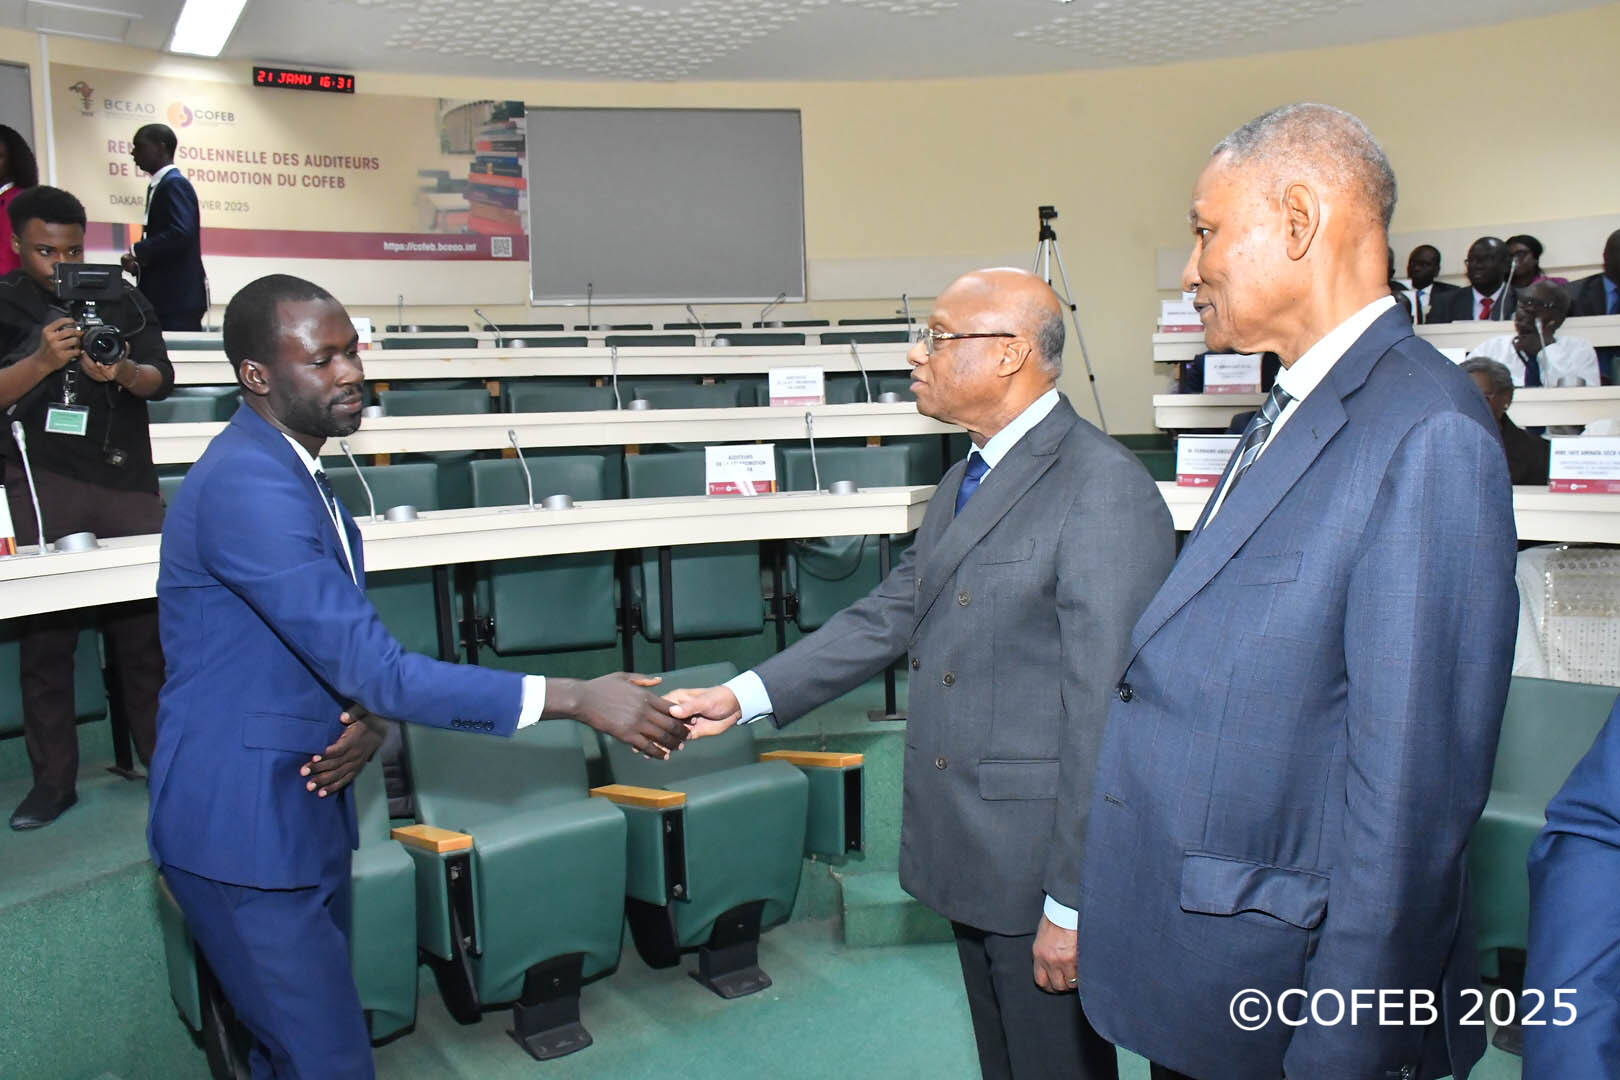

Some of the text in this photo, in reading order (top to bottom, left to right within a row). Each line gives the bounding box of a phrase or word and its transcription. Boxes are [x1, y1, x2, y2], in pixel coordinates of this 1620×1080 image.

[257, 70, 273, 83] 21
[277, 72, 312, 86] JANV
[104, 99, 156, 114] BCEAO
[194, 109, 235, 122] COFEB
[179, 145, 268, 164] SOLENNELLE
[272, 152, 300, 167] DES
[304, 154, 380, 170] AUDITEURS
[108, 162, 129, 176] DE
[187, 168, 272, 185] PROMOTION
[277, 173, 297, 187] DU
[302, 175, 346, 189] COFEB
[224, 200, 250, 212] 2025
